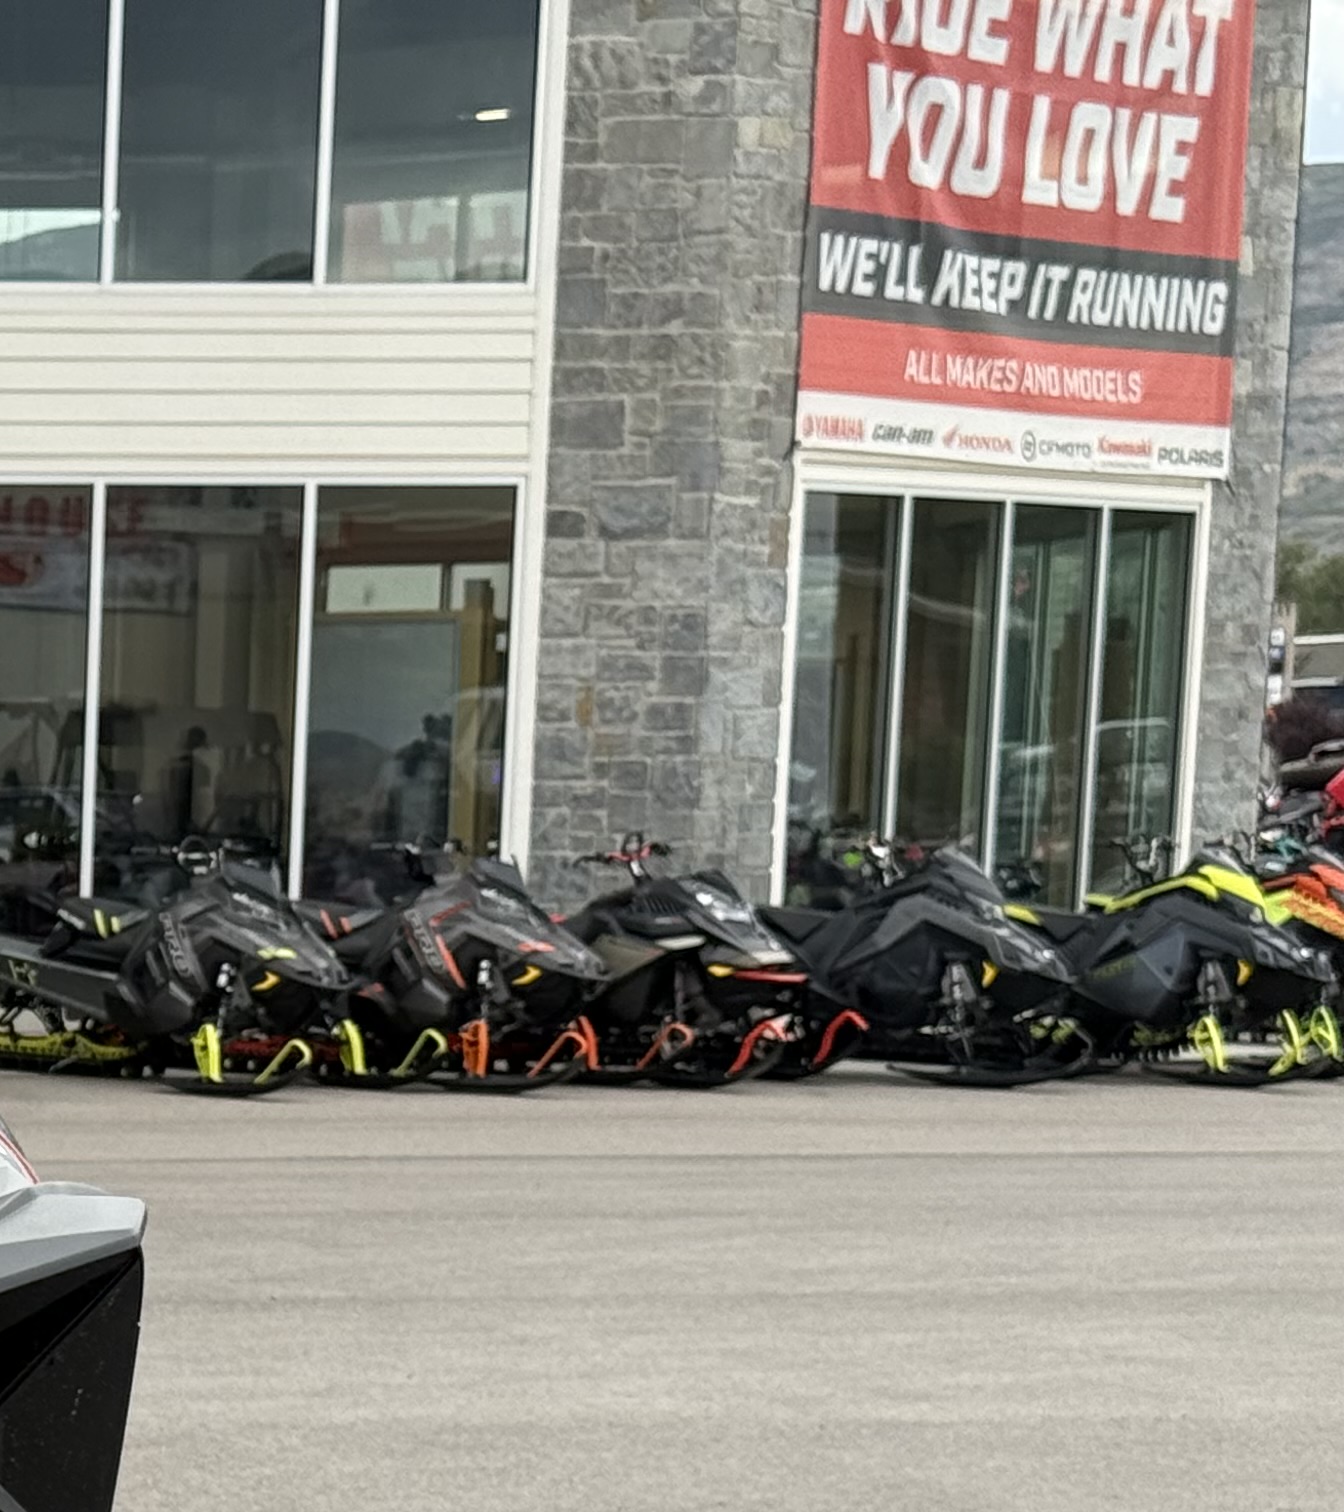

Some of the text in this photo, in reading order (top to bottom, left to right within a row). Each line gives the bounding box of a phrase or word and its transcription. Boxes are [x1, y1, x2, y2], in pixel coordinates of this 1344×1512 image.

[1033, 0, 1233, 97] WHAT
[867, 62, 1201, 224] YOU LOVE
[817, 230, 1229, 337] WE'LL KEEP IT RUNNING
[904, 349, 1144, 405] ALL MAKES AND MODELS
[958, 432, 1014, 454] HONDA
[1039, 439, 1091, 459] CFMOTO
[1157, 446, 1224, 469] POLARIS
